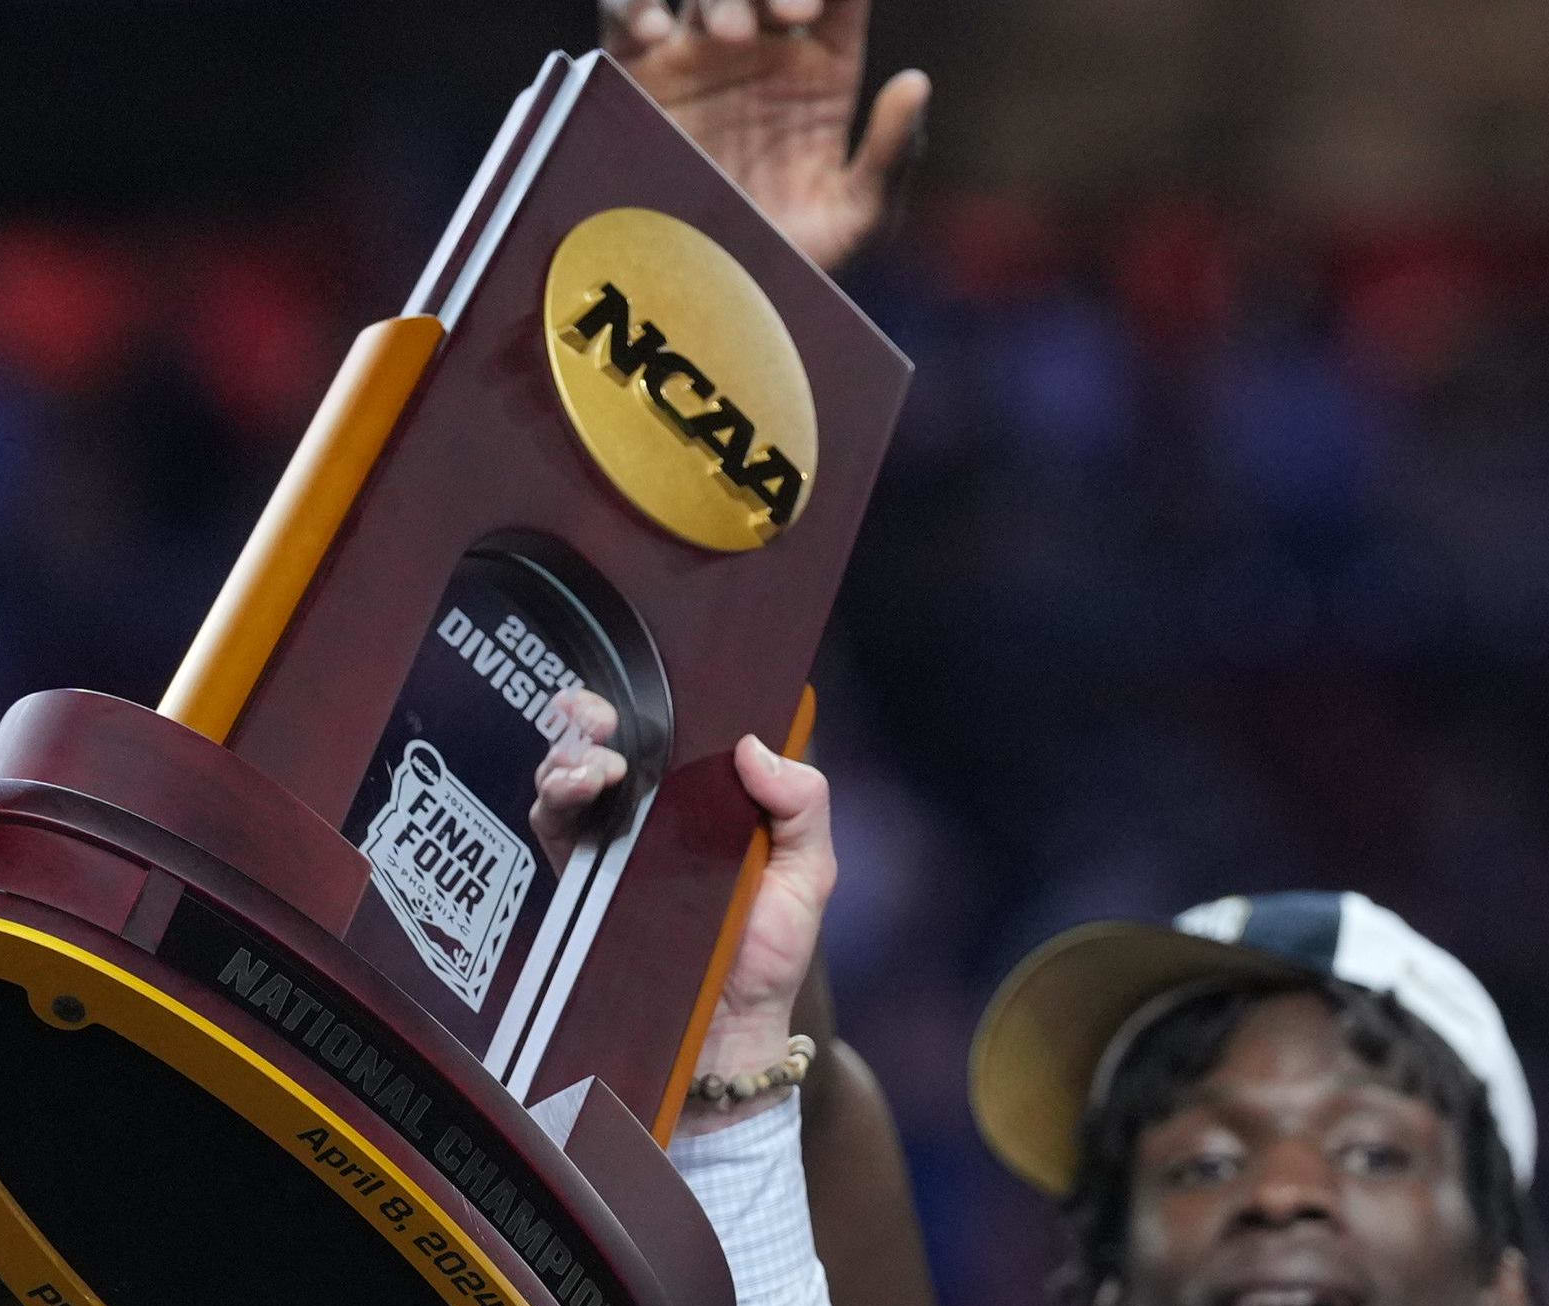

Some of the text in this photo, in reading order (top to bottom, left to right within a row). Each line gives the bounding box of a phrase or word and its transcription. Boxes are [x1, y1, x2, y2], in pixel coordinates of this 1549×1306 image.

[574, 282, 805, 526] NCAA
[394, 820, 485, 917] FOUR
[408, 789, 498, 888] FINAL
[401, 869, 454, 924] PHOENIX
[217, 948, 437, 1140] NATIONAL
[297, 1127, 385, 1197] April
[379, 1195, 413, 1232] 8,
